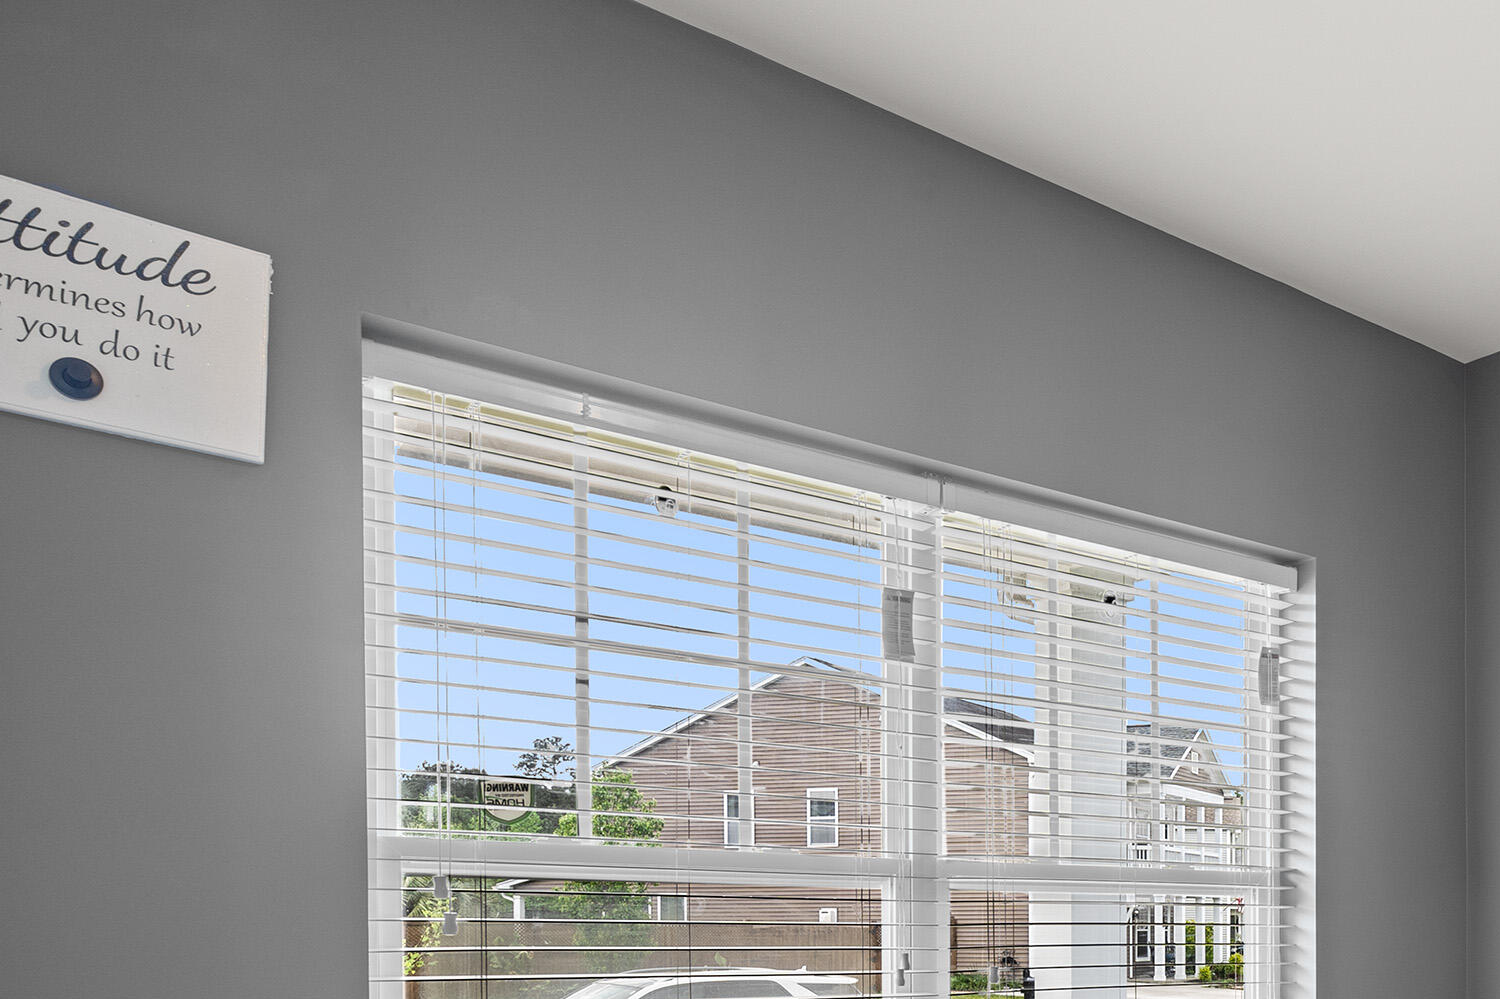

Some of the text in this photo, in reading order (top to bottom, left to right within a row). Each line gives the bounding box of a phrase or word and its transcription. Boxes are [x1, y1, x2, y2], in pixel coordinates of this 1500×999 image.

[0, 198, 217, 296] ttitude
[0, 272, 202, 337] rmines how
[16, 315, 176, 371] you do it
